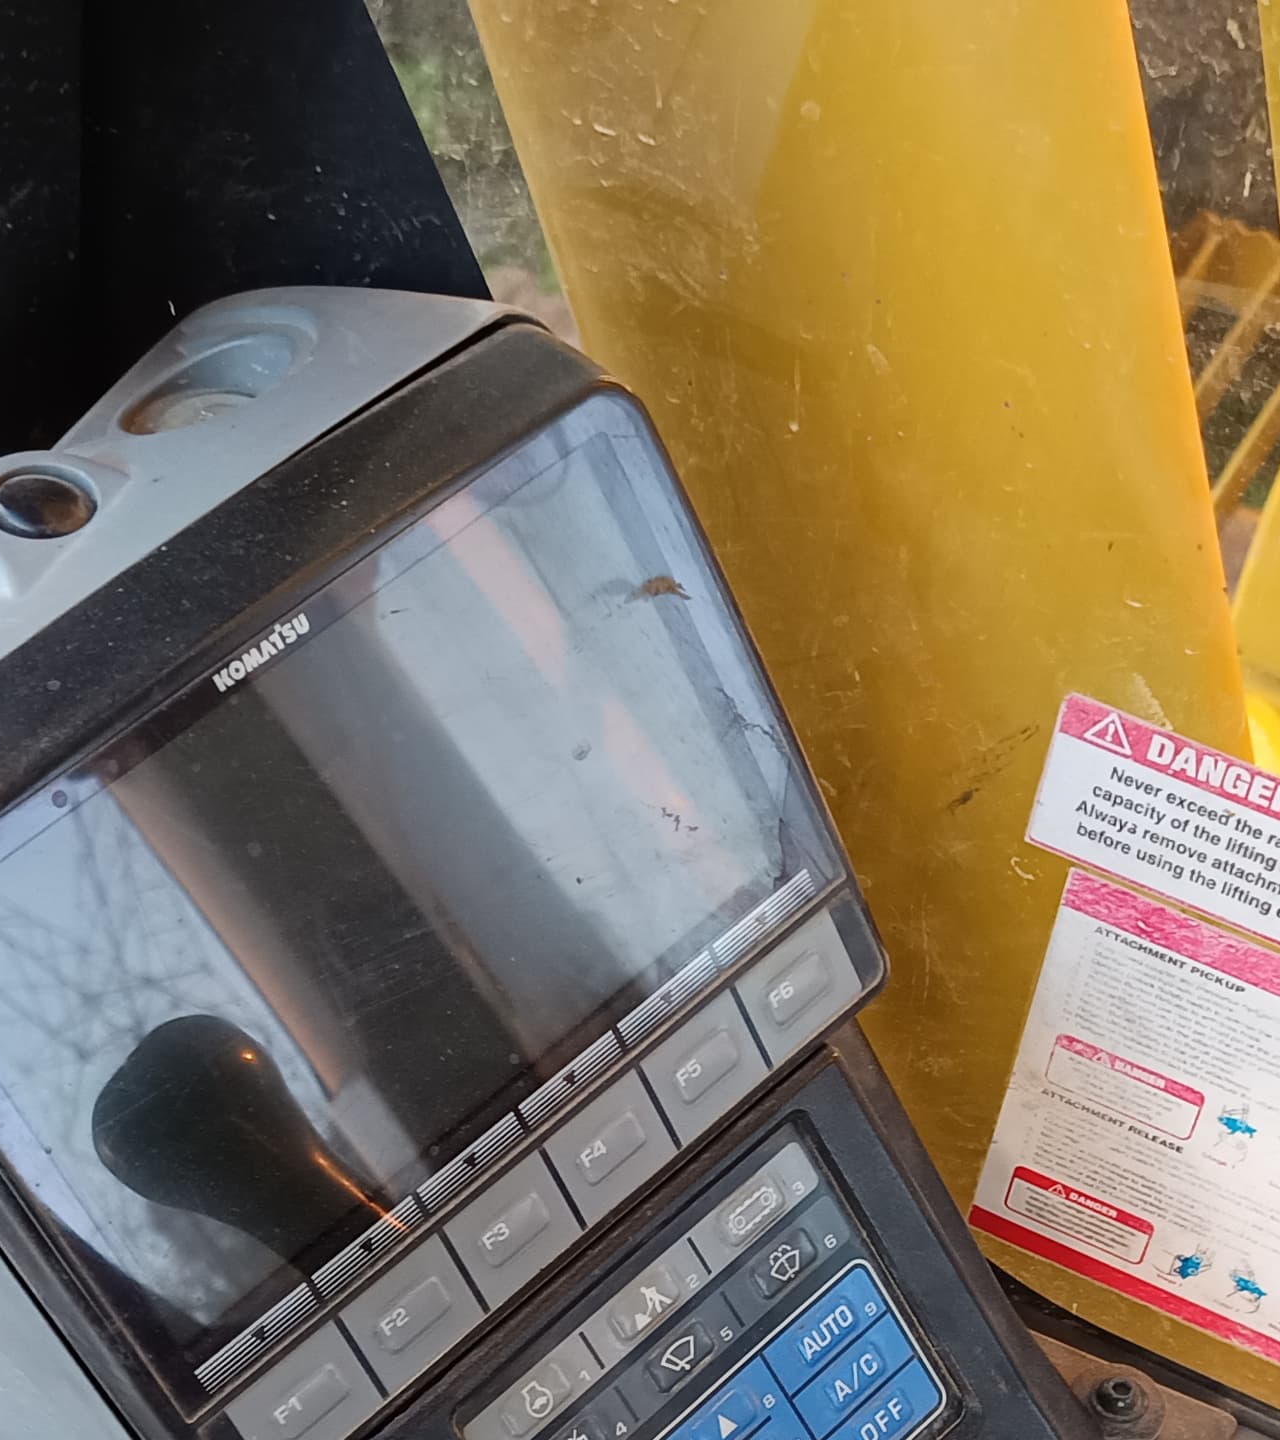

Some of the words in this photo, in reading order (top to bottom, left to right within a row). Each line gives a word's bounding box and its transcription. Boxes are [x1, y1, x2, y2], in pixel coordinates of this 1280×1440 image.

[213, 612, 310, 692] KOMATSU
[1108, 766, 1163, 799] Never
[1164, 789, 1231, 827] exceed
[1233, 817, 1265, 840] the
[1089, 783, 1166, 826] capacity
[1167, 815, 1189, 836] of
[1190, 824, 1222, 849] the
[1223, 837, 1278, 872] lifting
[1140, 826, 1209, 865] remove
[1074, 822, 1132, 856] before
[1133, 846, 1185, 878] using
[1186, 868, 1218, 892] the
[1219, 881, 1273, 915] lifting
[1093, 925, 1187, 971] ATTACHMENT
[1188, 964, 1247, 995] PICKUP
[766, 979, 796, 1009] F6
[674, 1057, 704, 1087] F5
[1039, 1087, 1125, 1129] ATTACHMENT
[1126, 1123, 1185, 1154] RELEASE
[578, 1138, 608, 1168] F4
[790, 1180, 805, 1196] 3
[1067, 1191, 1119, 1219] DANGER
[480, 1220, 512, 1251] F3
[822, 1232, 838, 1249] 6
[685, 1272, 700, 1289] 2
[377, 1304, 410, 1338] F2
[862, 1300, 878, 1318] 9
[718, 1324, 734, 1342] 5
[797, 1304, 855, 1361] AUTO
[578, 1368, 592, 1384] 1
[828, 1350, 880, 1402] A/C
[272, 1395, 305, 1427] F1
[761, 1392, 776, 1409] 8
[612, 1420, 628, 1438] 4
